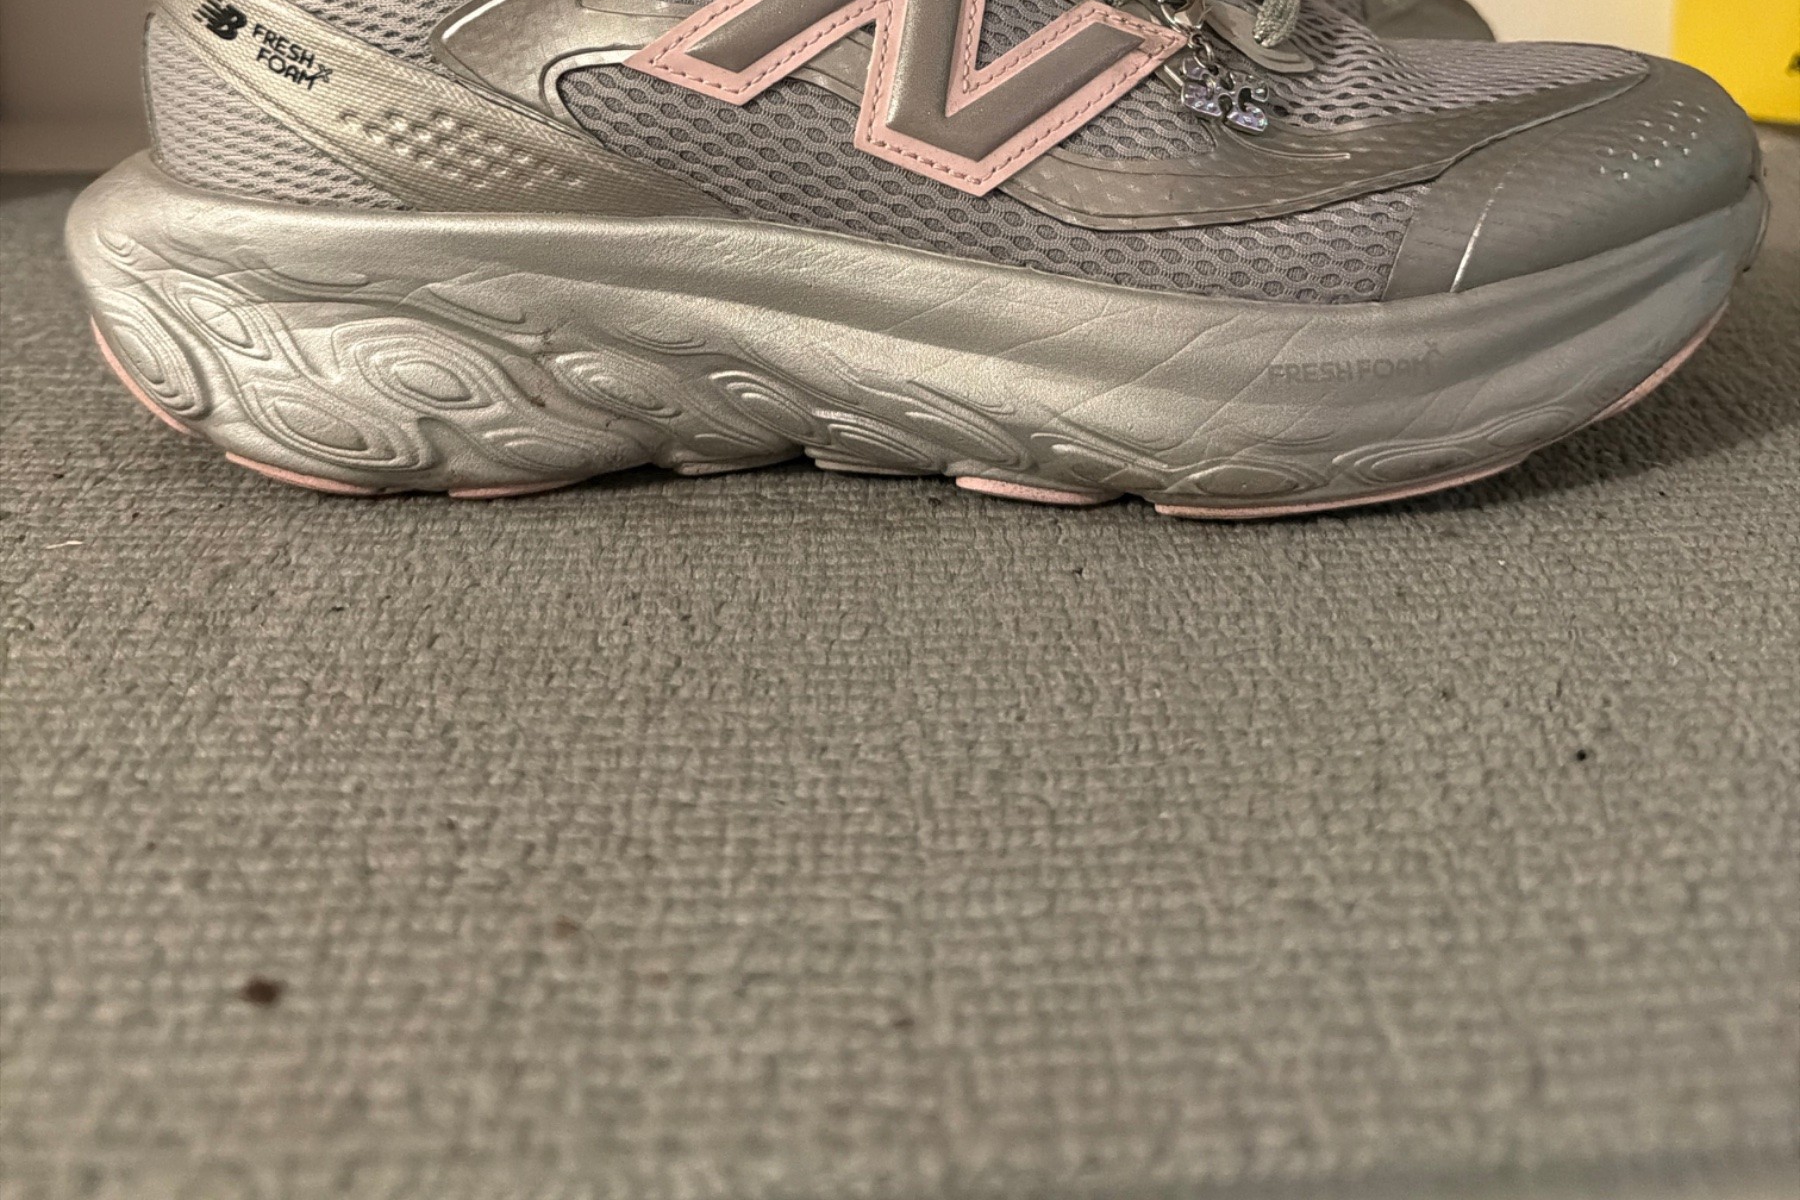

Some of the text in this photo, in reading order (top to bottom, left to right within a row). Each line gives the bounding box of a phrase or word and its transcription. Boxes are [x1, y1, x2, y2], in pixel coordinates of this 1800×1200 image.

[252, 23, 316, 68] FRESH
[256, 46, 316, 91] FOAM
[1268, 360, 1354, 385] FRESH
[1356, 357, 1432, 381] FOAM
